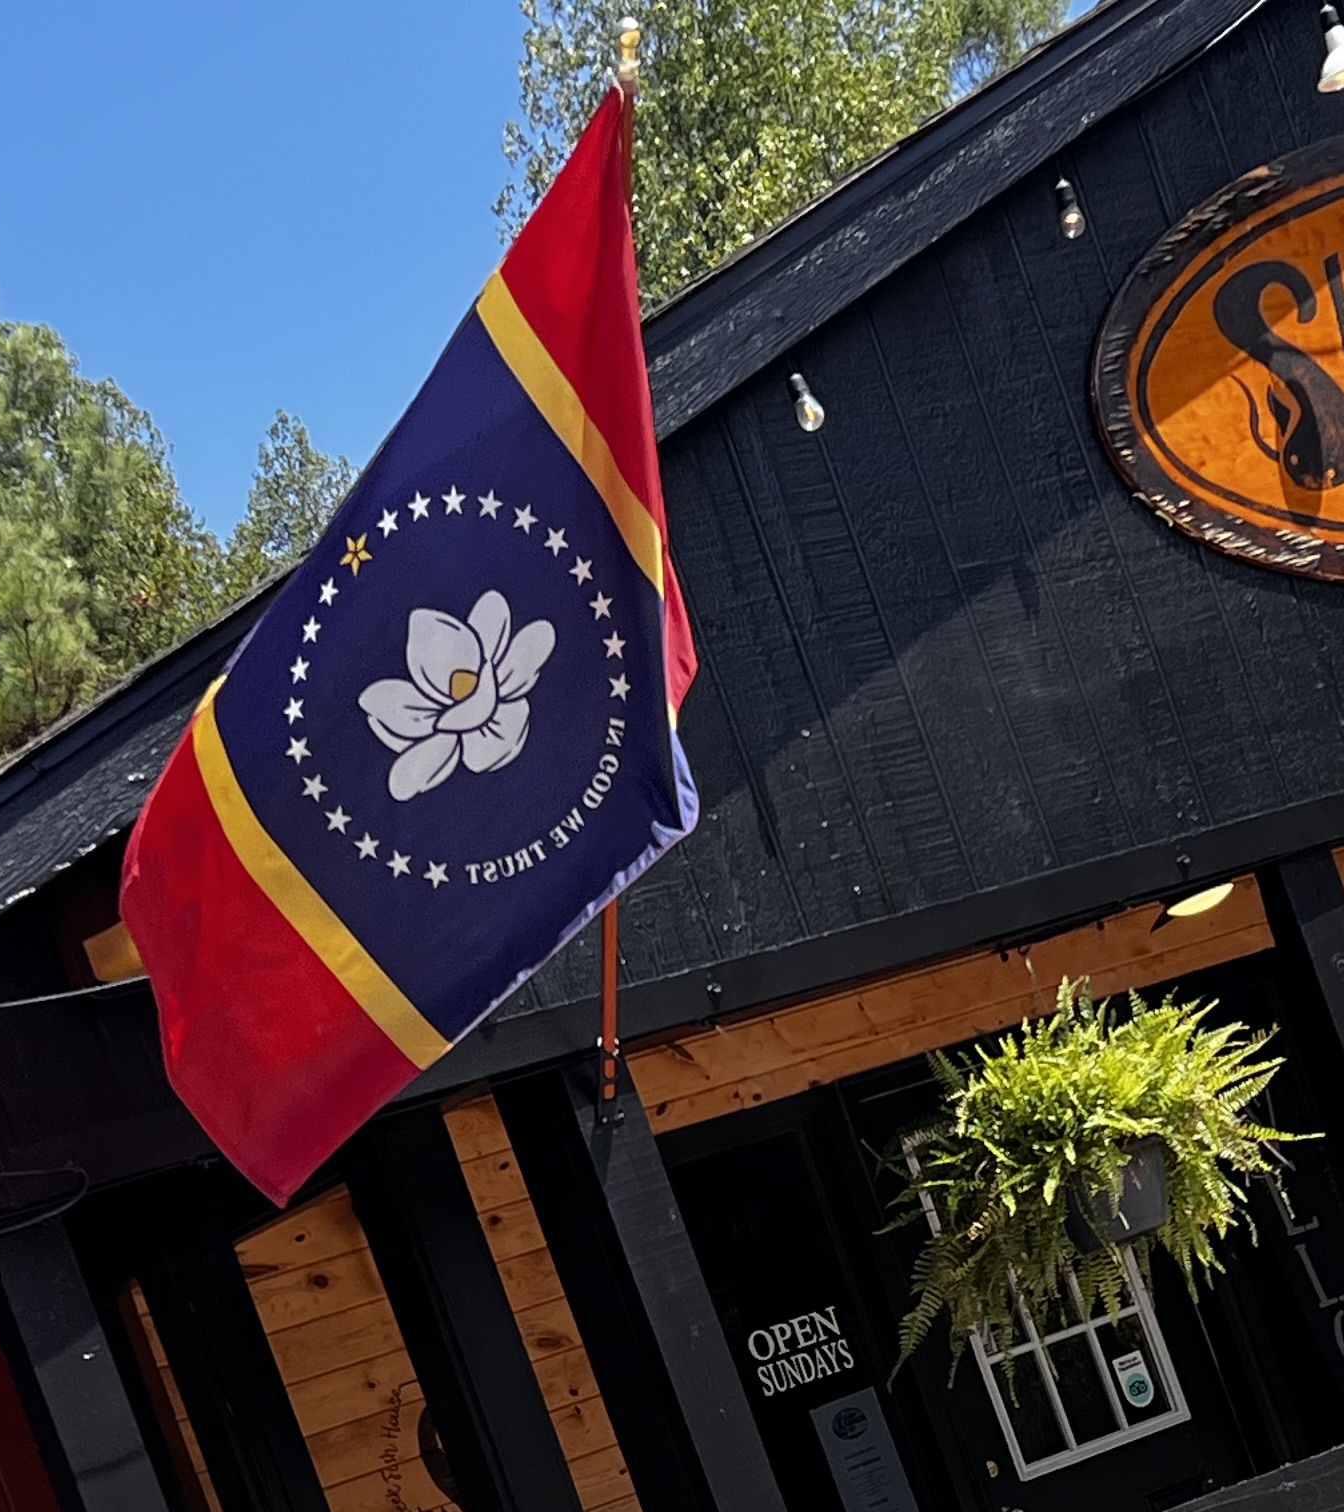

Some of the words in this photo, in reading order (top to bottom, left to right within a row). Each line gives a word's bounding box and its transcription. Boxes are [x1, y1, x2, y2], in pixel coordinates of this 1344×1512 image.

[747, 1305, 842, 1362] OPEN
[757, 1339, 855, 1397] SUNDAYS
[382, 1386, 402, 1441] House
